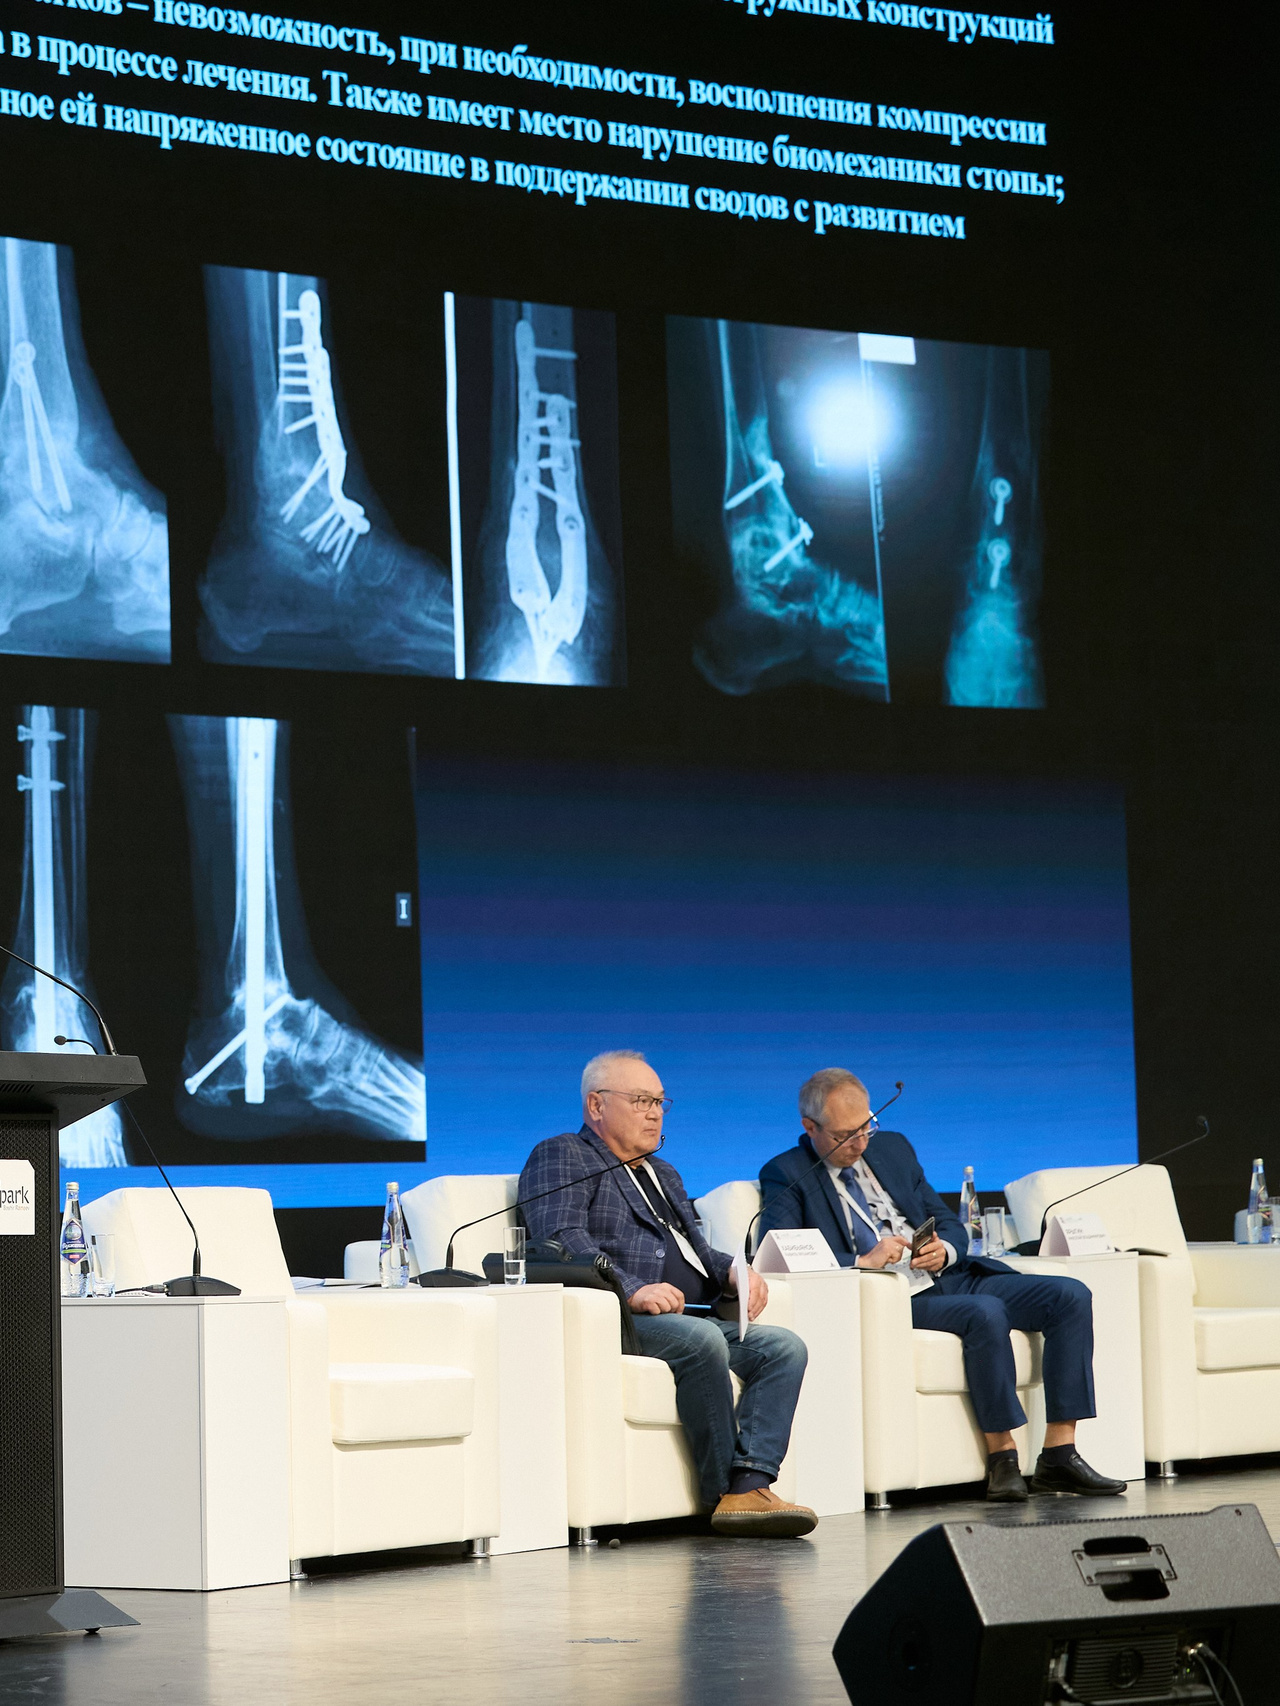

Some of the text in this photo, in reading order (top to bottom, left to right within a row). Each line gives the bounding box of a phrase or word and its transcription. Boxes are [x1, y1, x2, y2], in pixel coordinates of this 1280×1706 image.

[153, 0, 396, 66] невозможность,
[399, 35, 459, 75] при
[461, 43, 686, 108] необходимости,
[687, 79, 873, 127] восполнения
[876, 104, 1048, 147] компрессии
[865, 0, 1055, 45] конструкций
[9, 30, 32, 59] в
[36, 35, 179, 82] процессе
[181, 59, 318, 103] лечения.
[321, 69, 423, 118] Также
[425, 94, 515, 131] имеет
[517, 108, 604, 144] место
[606, 120, 770, 165] нарушение
[772, 134, 963, 188] биомеханики
[965, 166, 1066, 205] стопы;
[59, 90, 98, 128] ей
[102, 103, 312, 158] напряженное
[315, 135, 466, 179] состояние
[469, 156, 491, 183] в
[493, 159, 691, 209] поддержании
[694, 186, 790, 222] сводов
[793, 198, 810, 223] с
[812, 200, 967, 240] развитием
[0, 1185, 30, 1209] park
